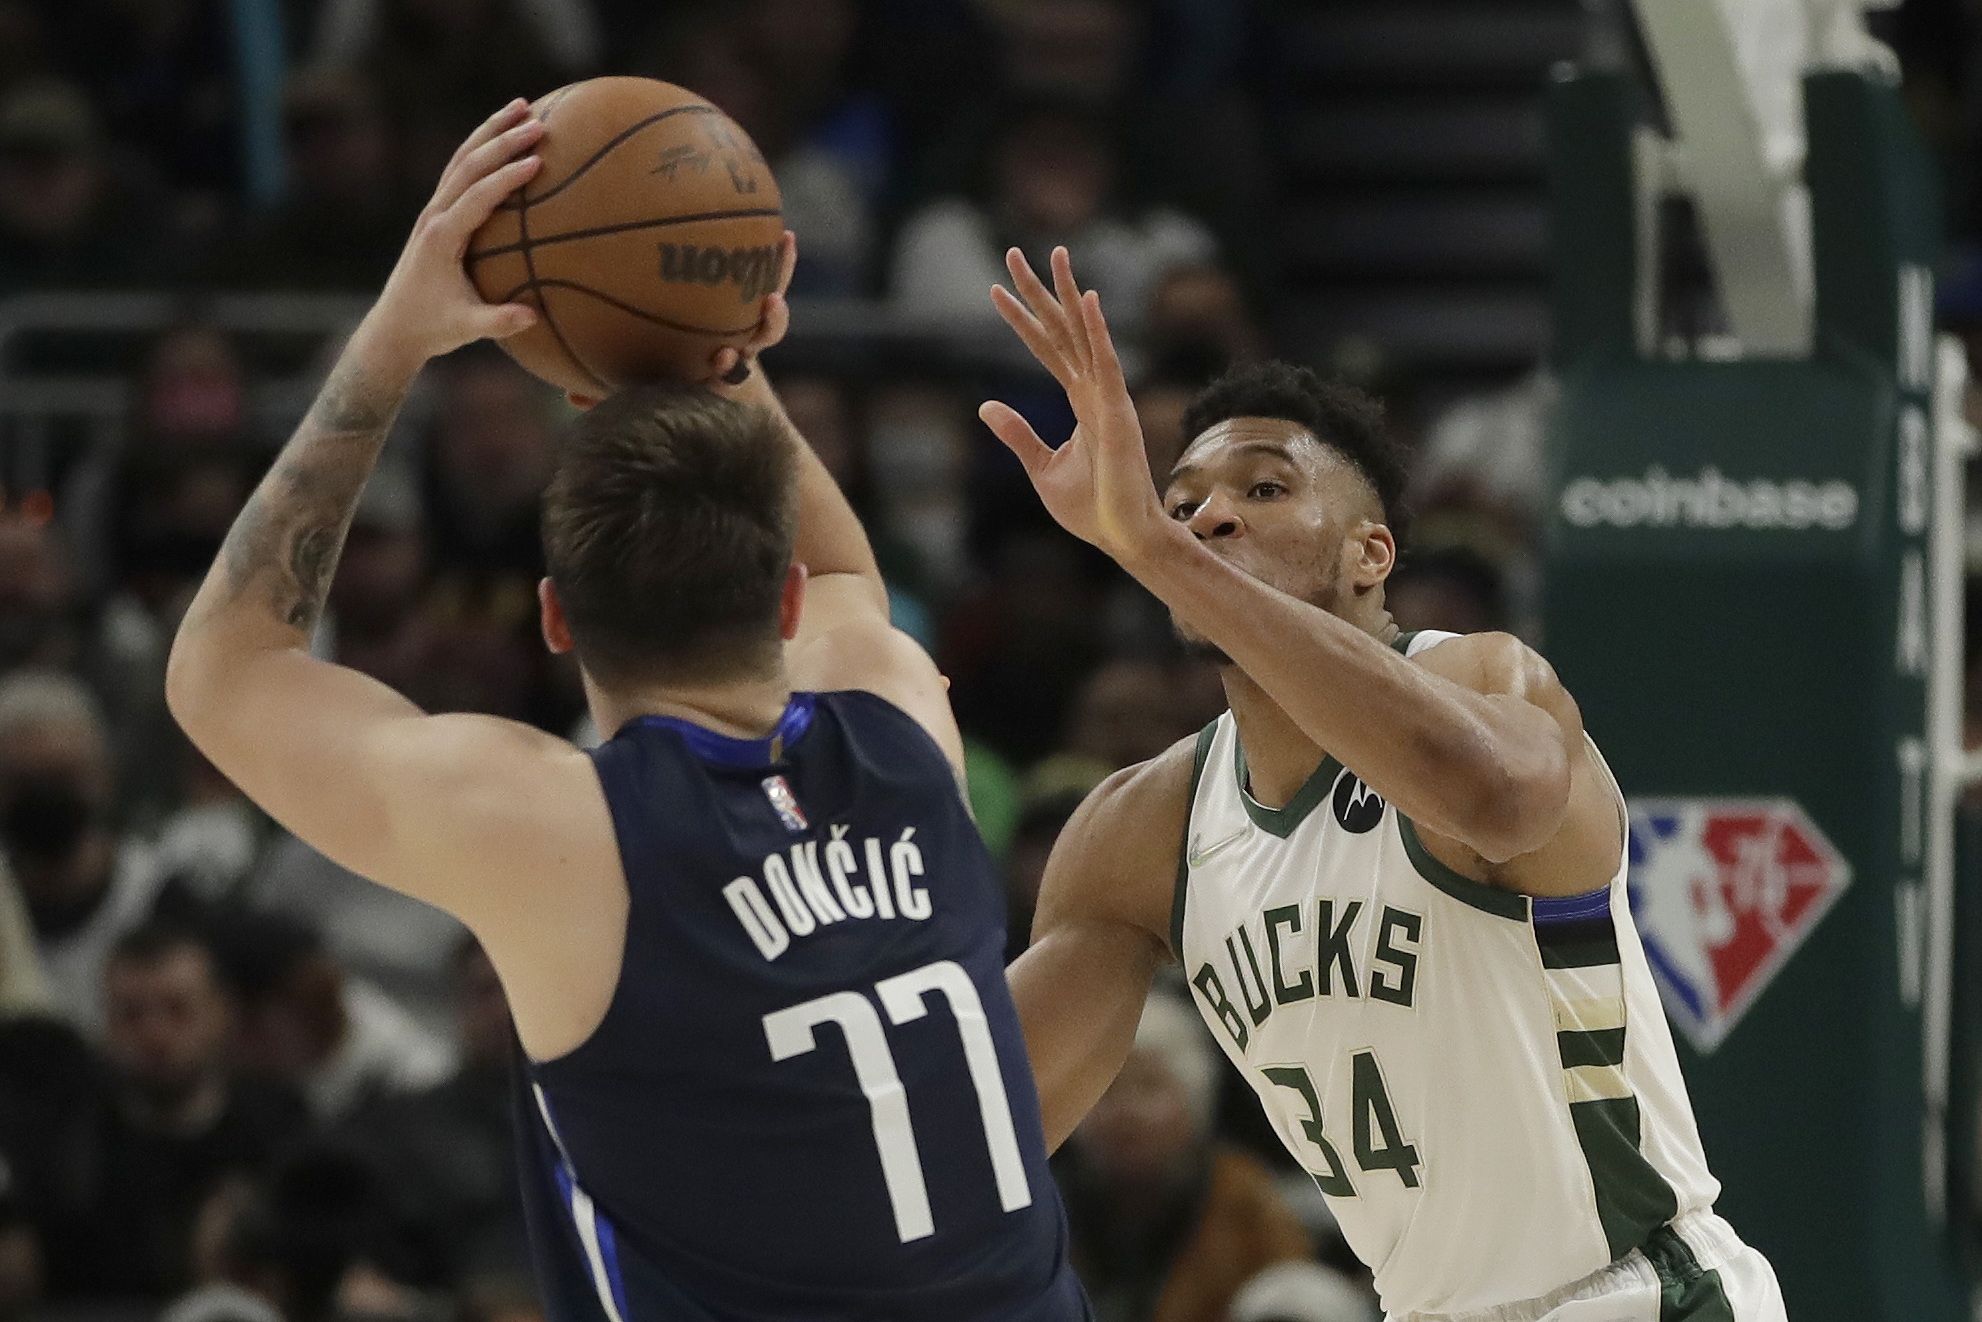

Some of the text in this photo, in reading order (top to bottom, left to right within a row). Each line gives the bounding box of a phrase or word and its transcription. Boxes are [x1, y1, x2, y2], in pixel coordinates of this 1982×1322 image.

[659, 243, 785, 302] ilson
[1560, 464, 1859, 529] coinbase
[722, 824, 933, 962] DONČIĆ
[1193, 900, 1423, 1056] BUCKS
[762, 960, 1032, 1243] 77
[1256, 1045, 1426, 1199] 34
